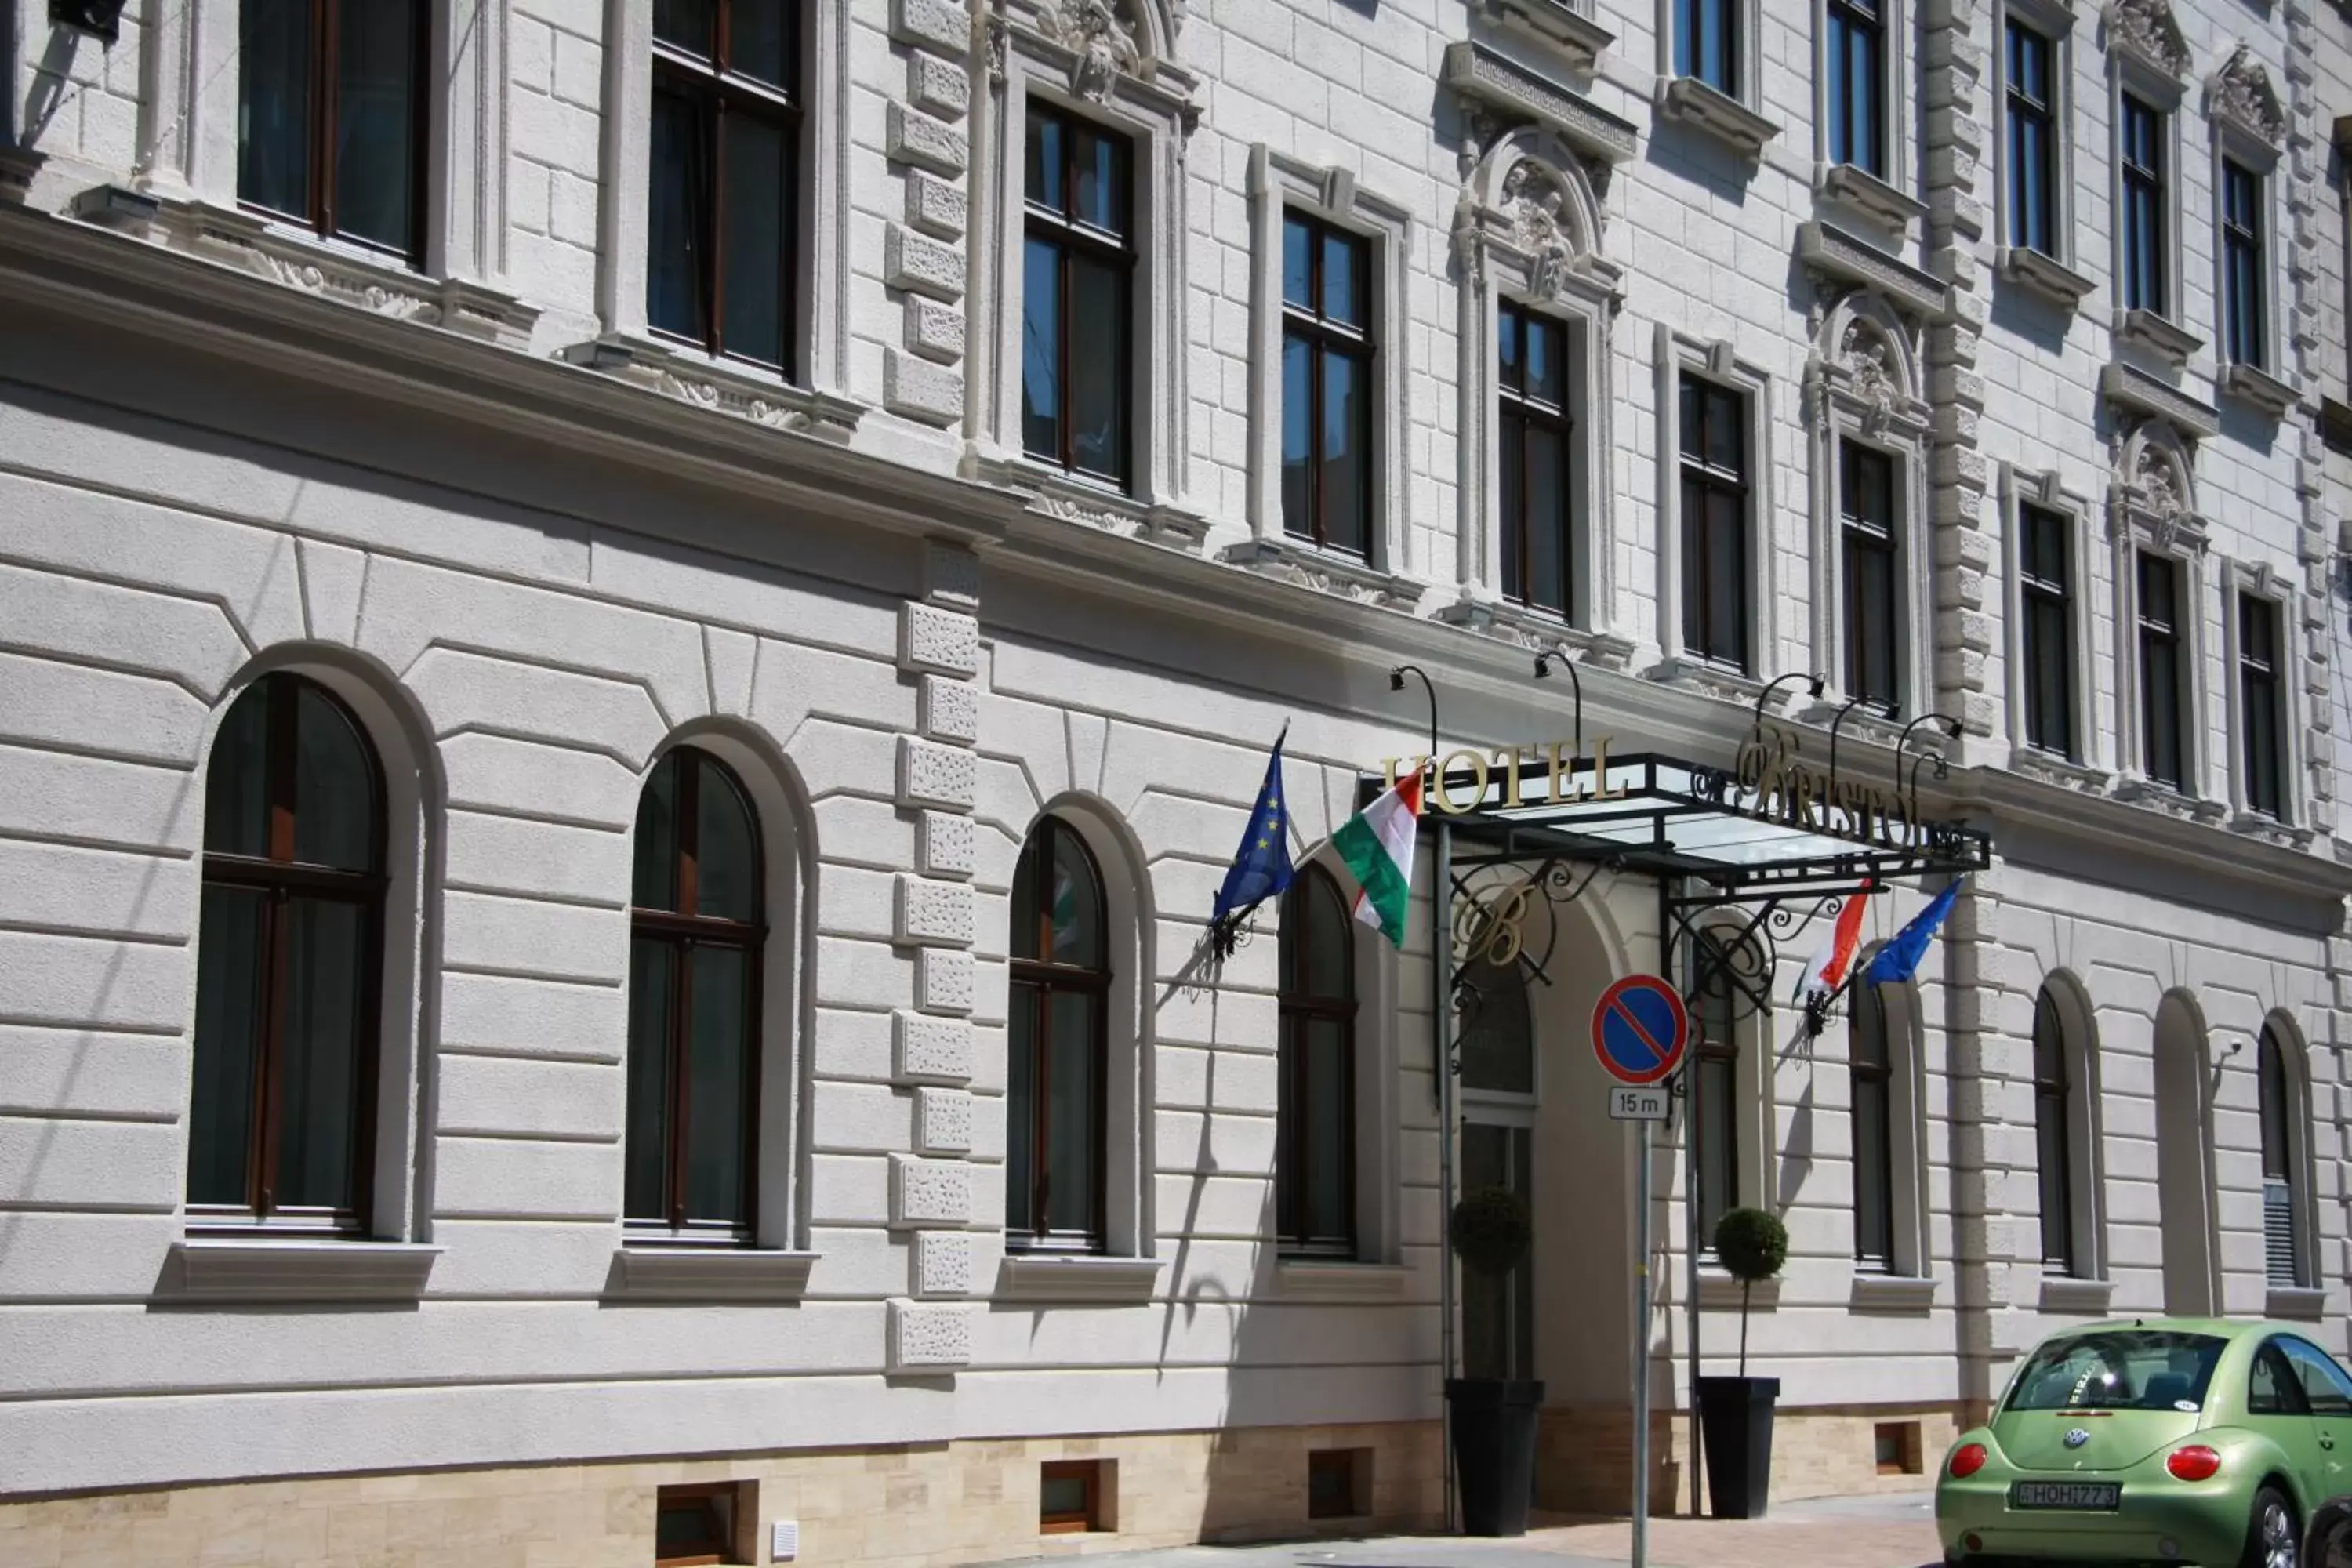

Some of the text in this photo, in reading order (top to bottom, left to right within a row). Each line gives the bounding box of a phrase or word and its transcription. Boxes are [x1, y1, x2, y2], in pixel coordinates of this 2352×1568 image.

[1380, 735, 1629, 815] HOTEL
[1621, 1094, 1658, 1112] 15 m
